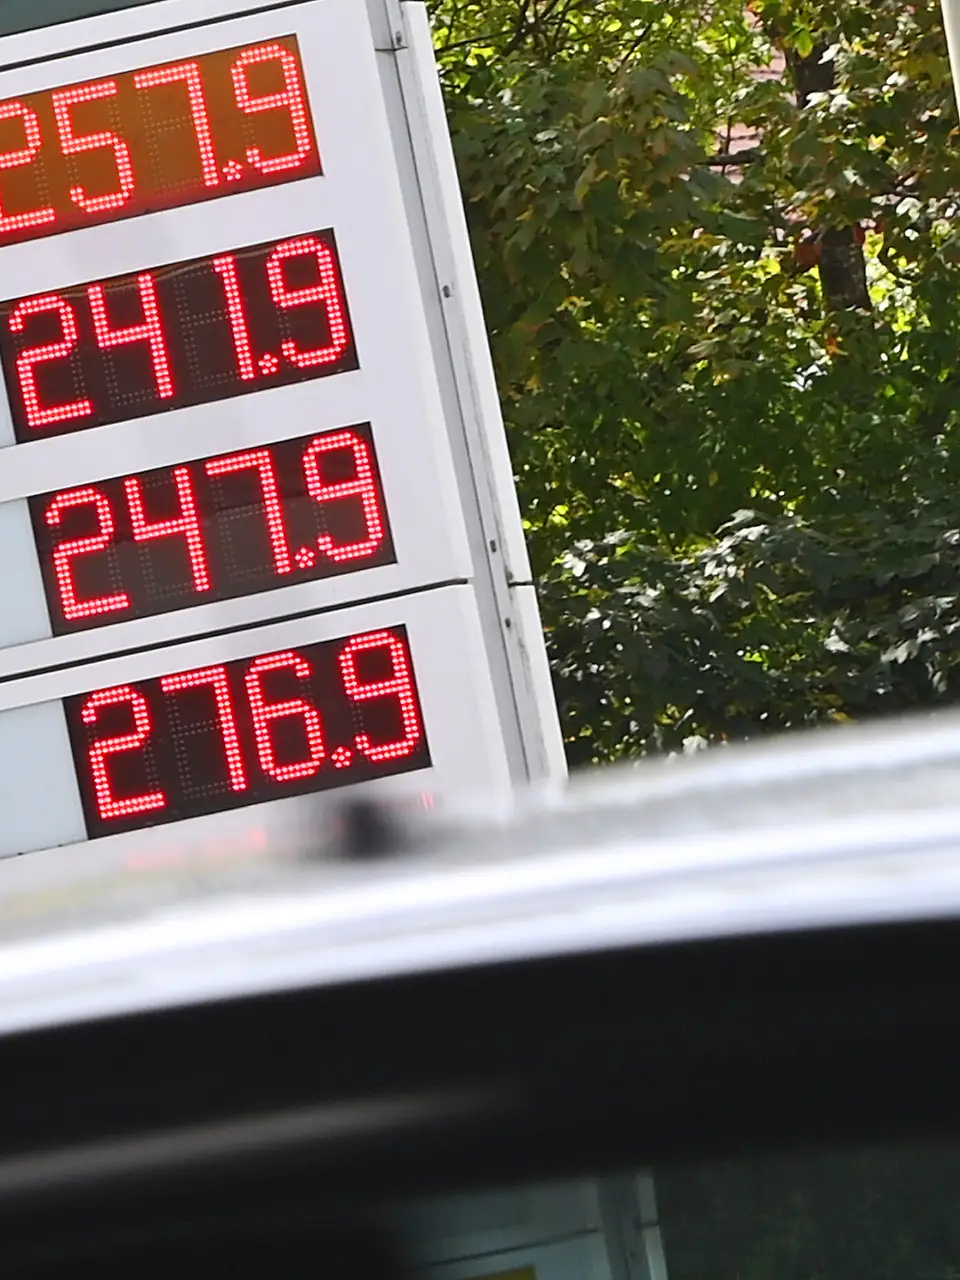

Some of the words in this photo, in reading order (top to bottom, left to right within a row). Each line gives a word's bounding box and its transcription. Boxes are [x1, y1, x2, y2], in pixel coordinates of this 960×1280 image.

[8, 236, 347, 427] 241.9
[45, 432, 384, 620] 247.9
[81, 631, 420, 819] 276.9
